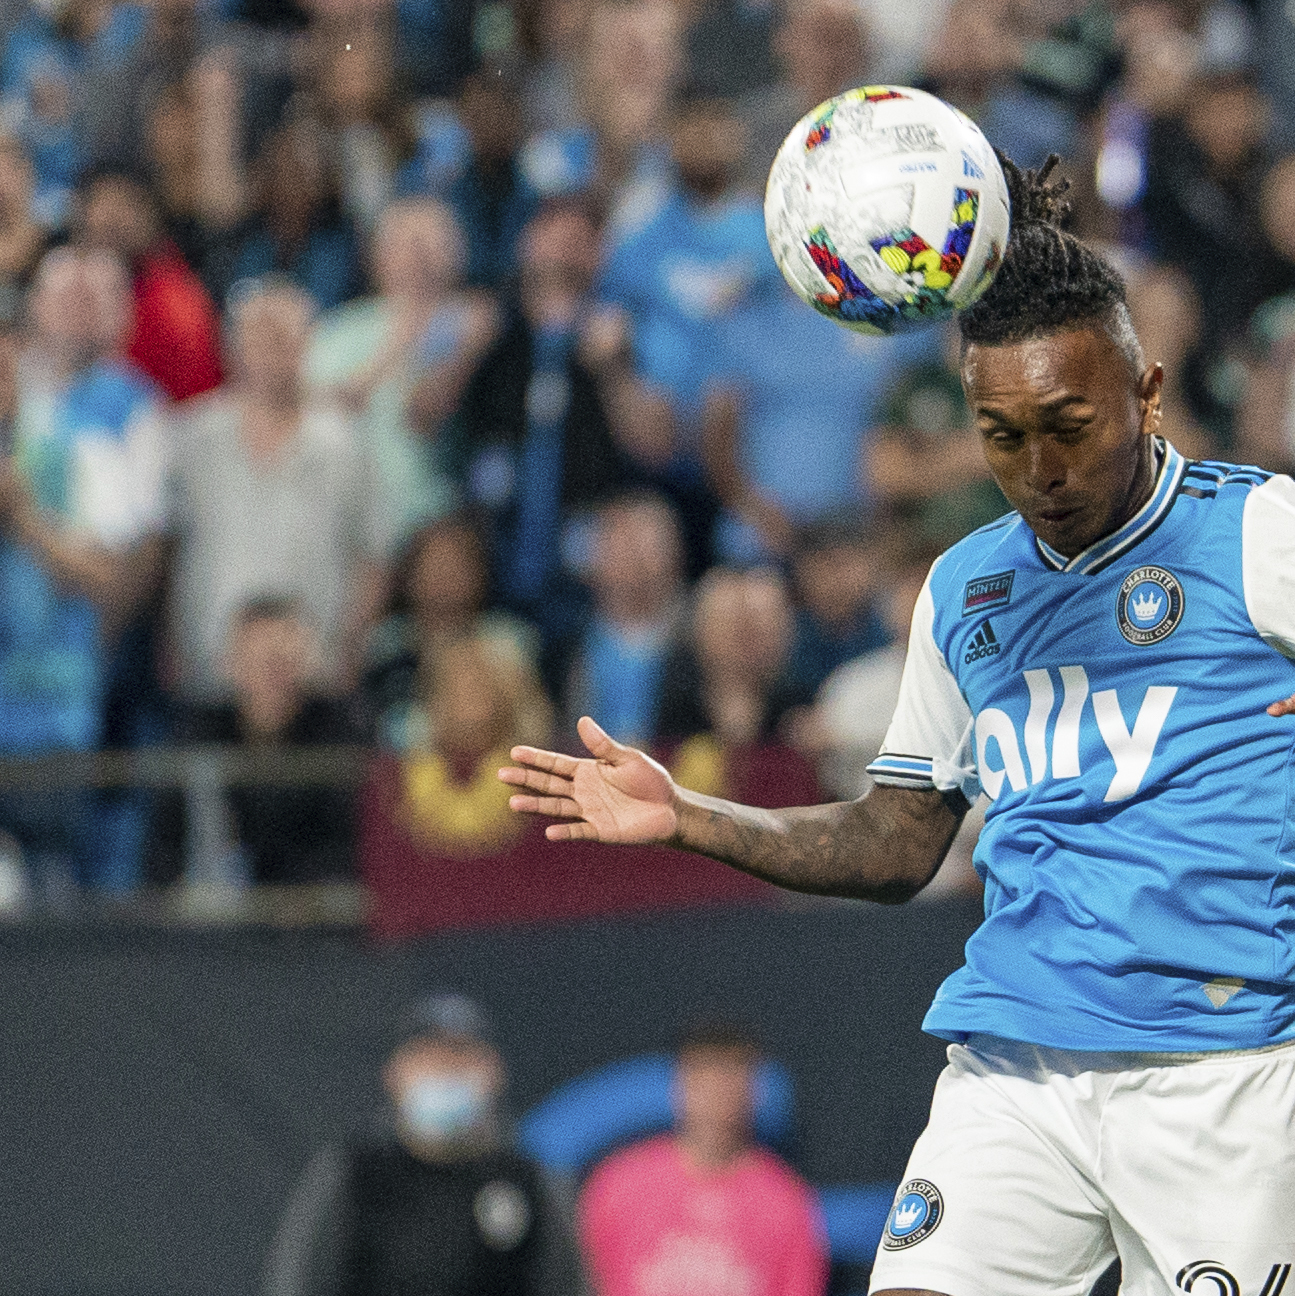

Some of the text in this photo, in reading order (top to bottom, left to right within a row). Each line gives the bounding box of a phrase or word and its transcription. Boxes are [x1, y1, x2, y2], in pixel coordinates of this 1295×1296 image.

[1122, 569, 1176, 593] CHARLOTTE
[964, 643, 1001, 665] adidas
[975, 665, 1180, 803] ally
